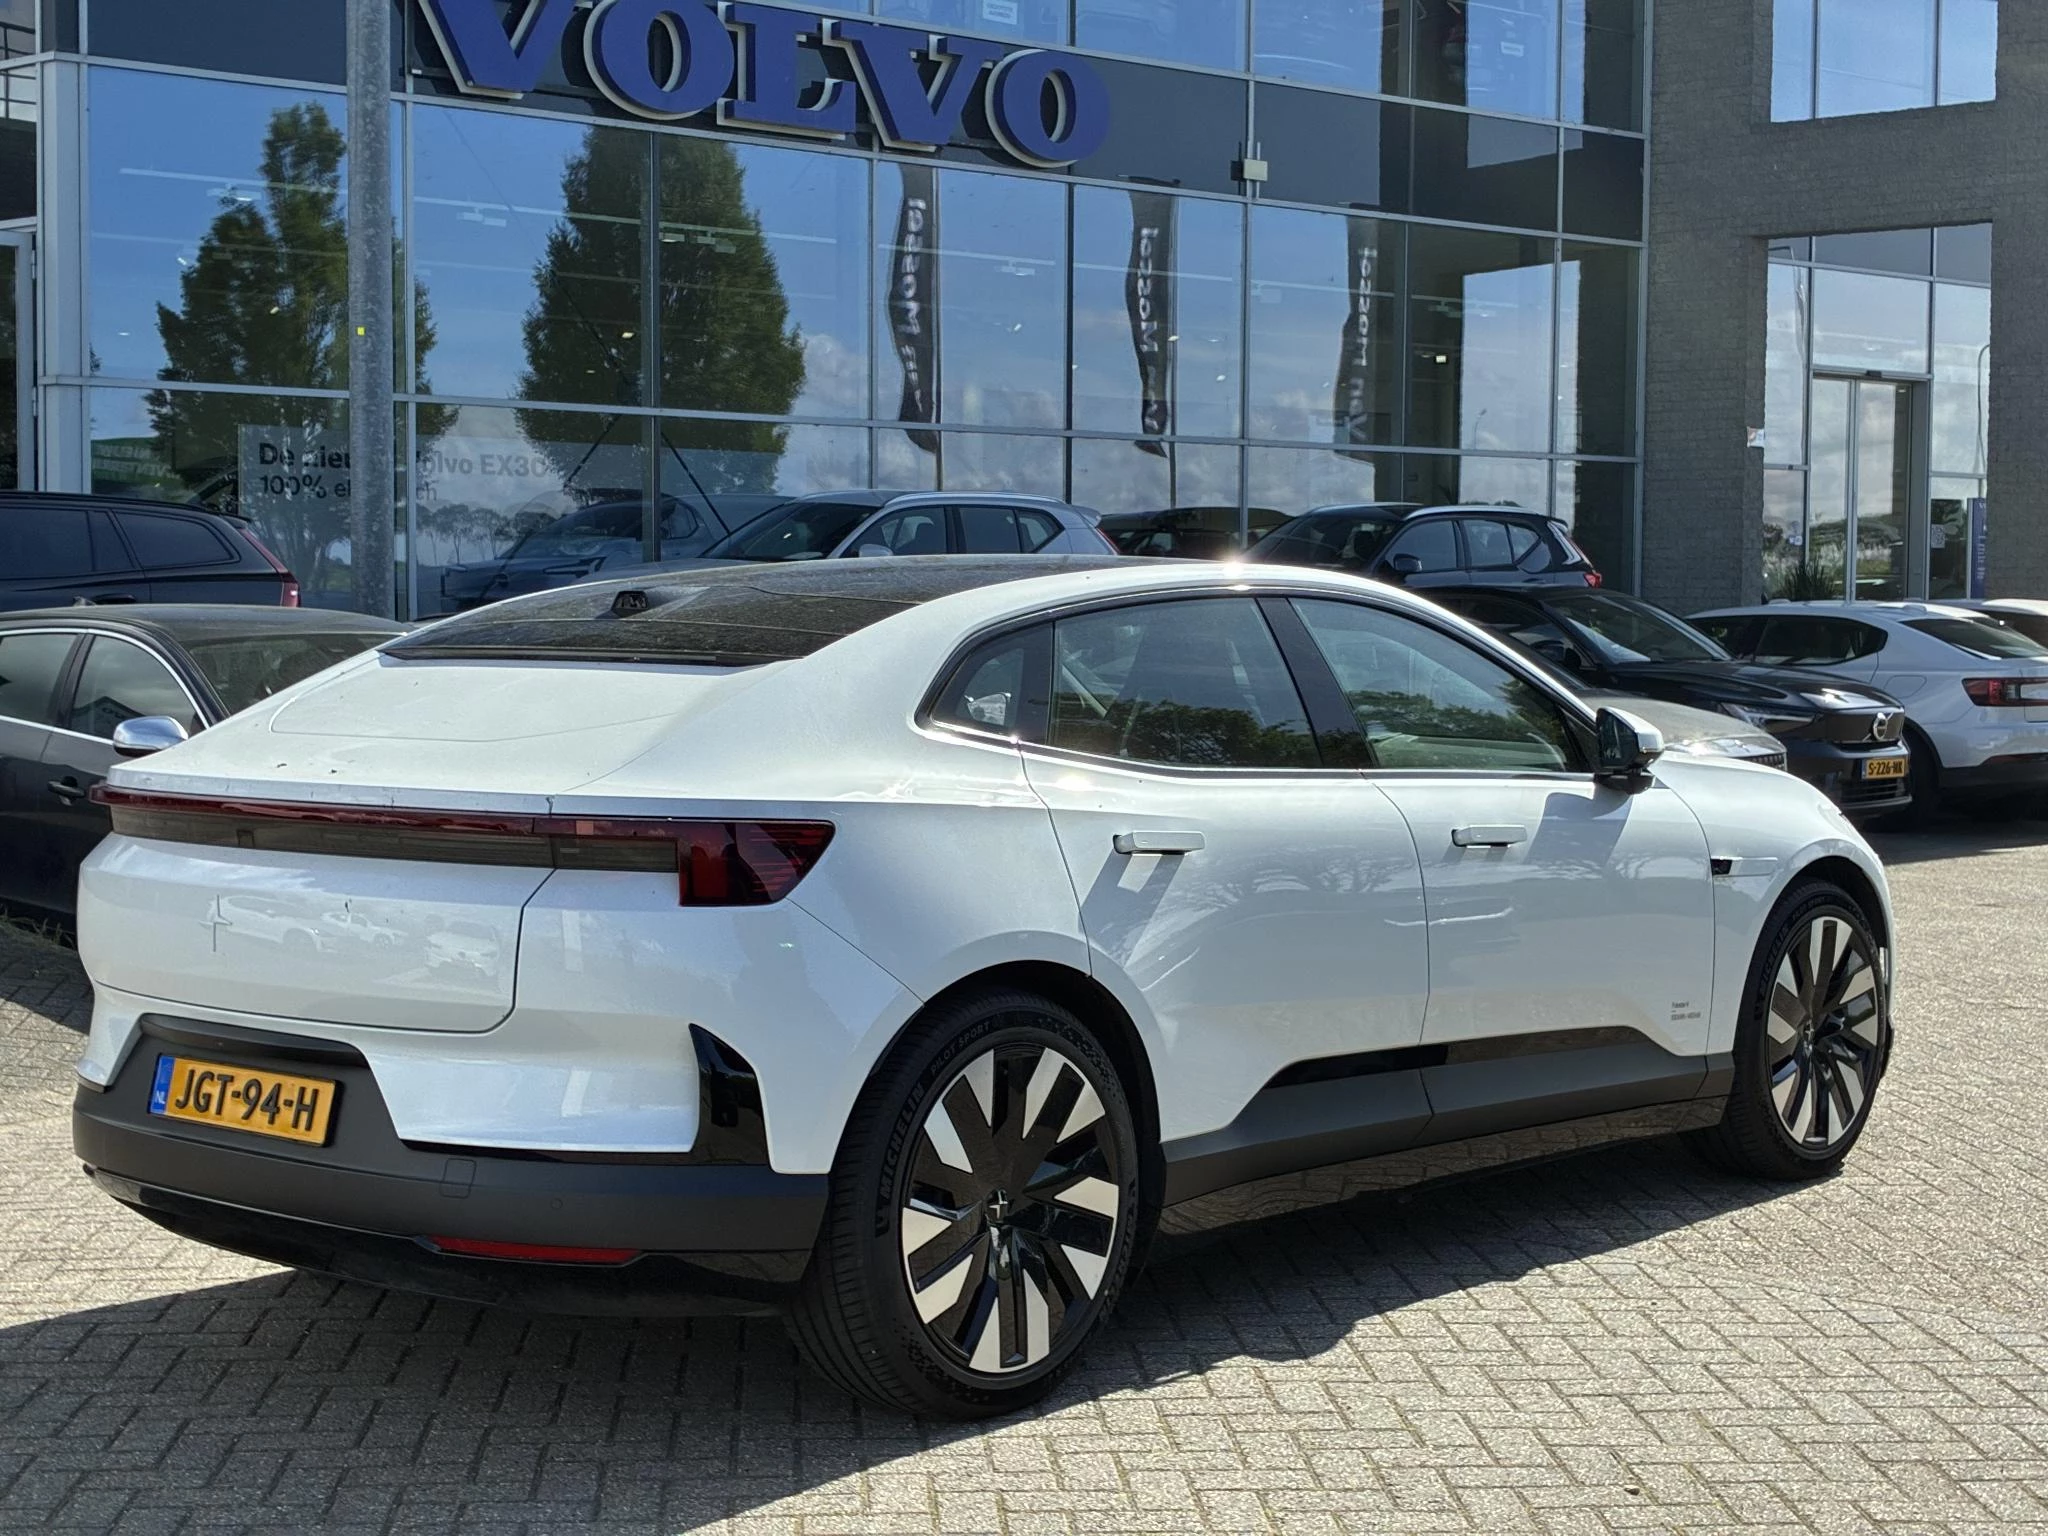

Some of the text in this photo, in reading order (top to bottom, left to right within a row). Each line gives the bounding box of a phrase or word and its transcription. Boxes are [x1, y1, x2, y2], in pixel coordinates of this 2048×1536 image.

[412, 0, 1110, 168] VOLVO
[259, 442, 295, 467] De
[259, 474, 327, 499] 100%
[930, 1020, 991, 1076] PILOT SPORT
[175, 1068, 319, 1132] JGT-94-H
[879, 1081, 926, 1197] MICHELIN
